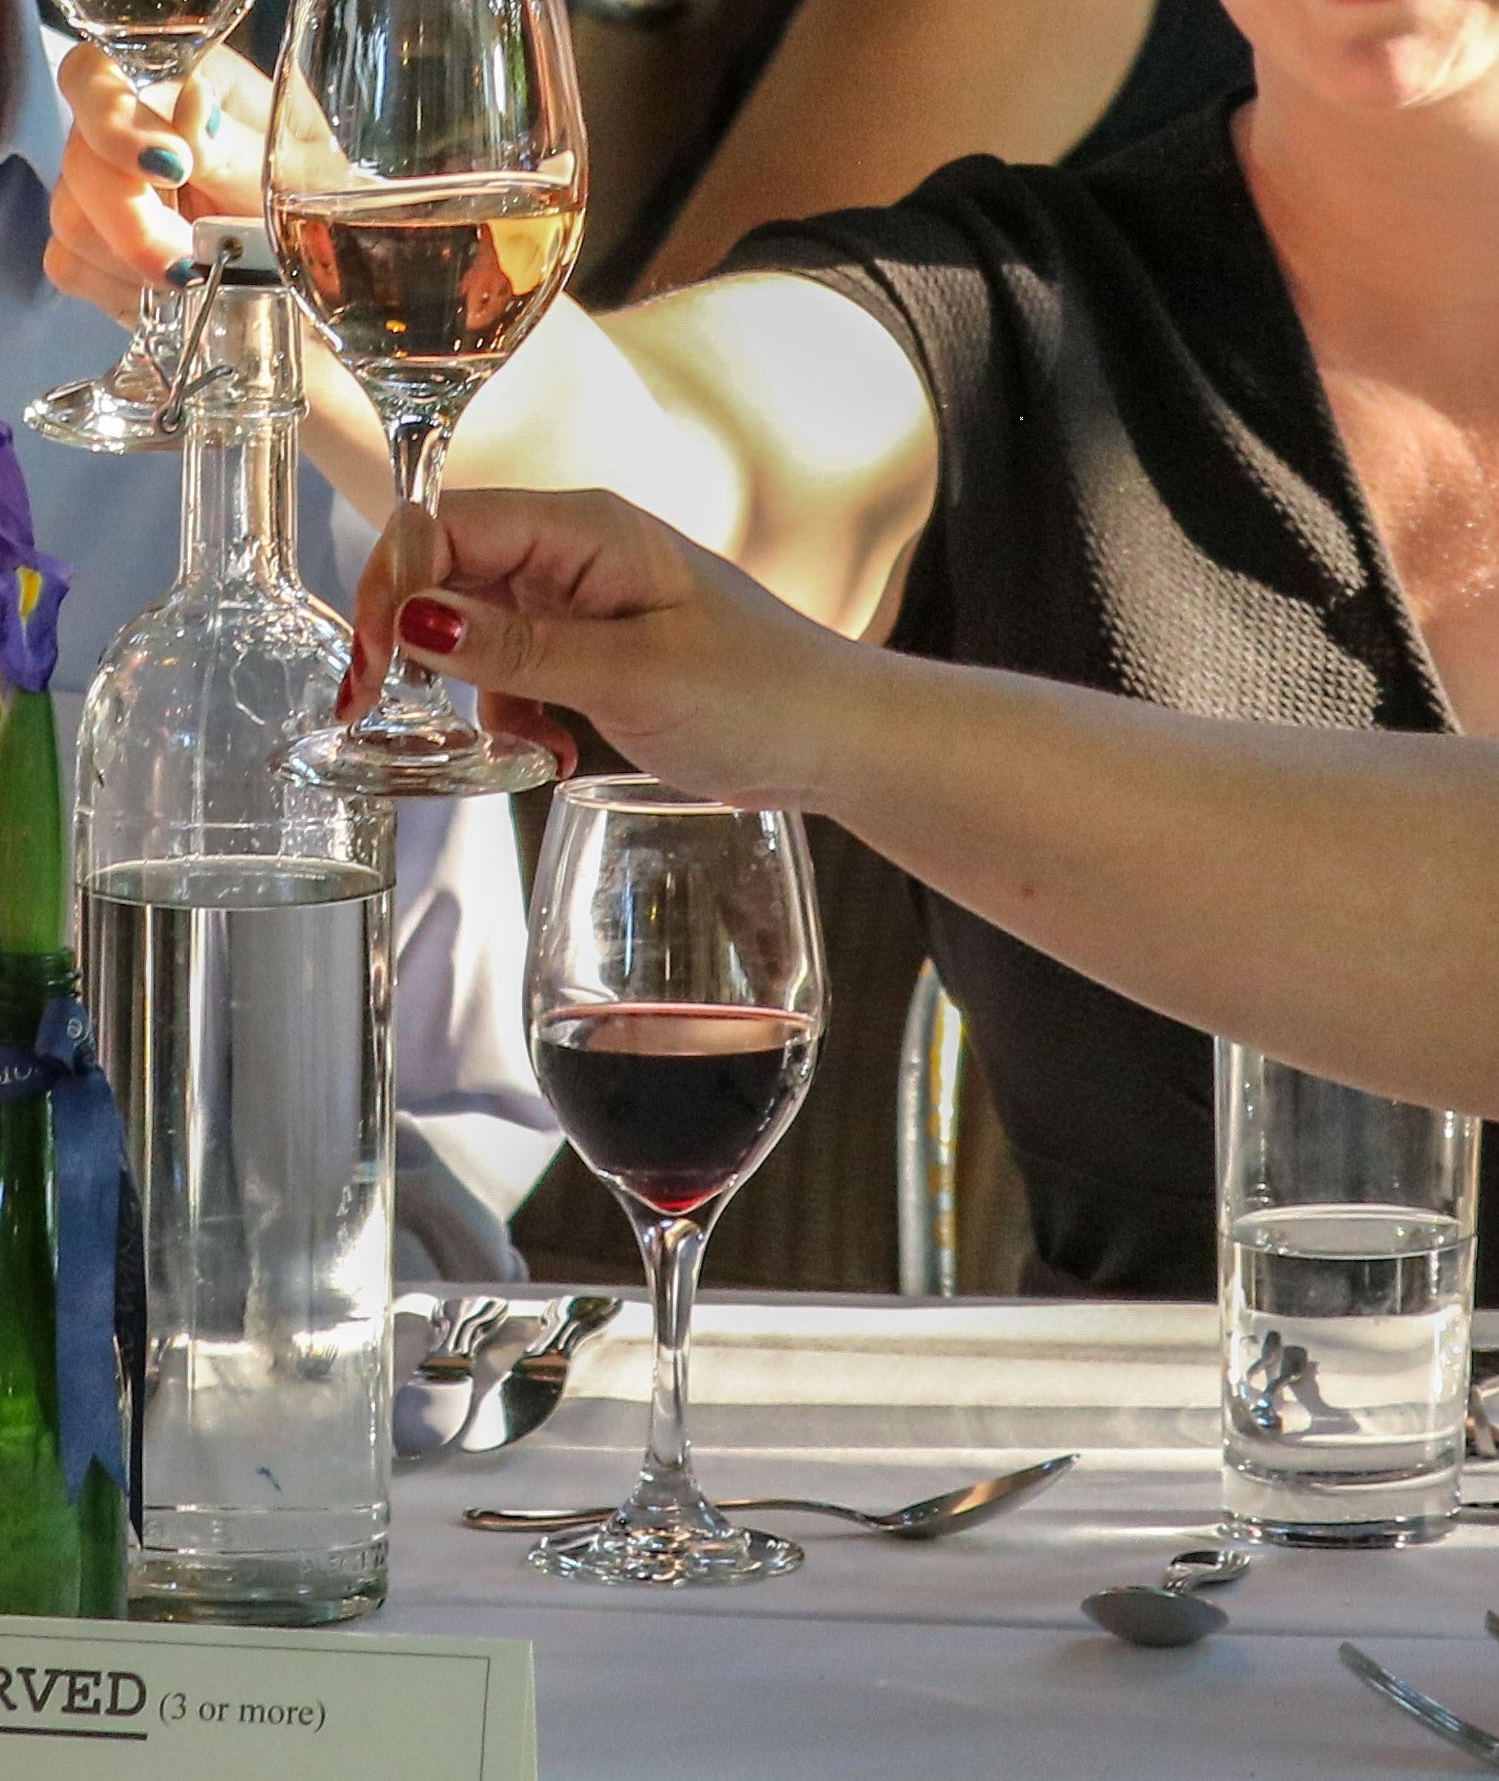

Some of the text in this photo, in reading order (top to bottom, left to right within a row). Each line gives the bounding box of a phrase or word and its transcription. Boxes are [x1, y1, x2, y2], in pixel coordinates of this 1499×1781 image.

[159, 1692, 187, 1721] (3
[198, 1702, 230, 1722] or
[239, 1704, 326, 1733] more)
